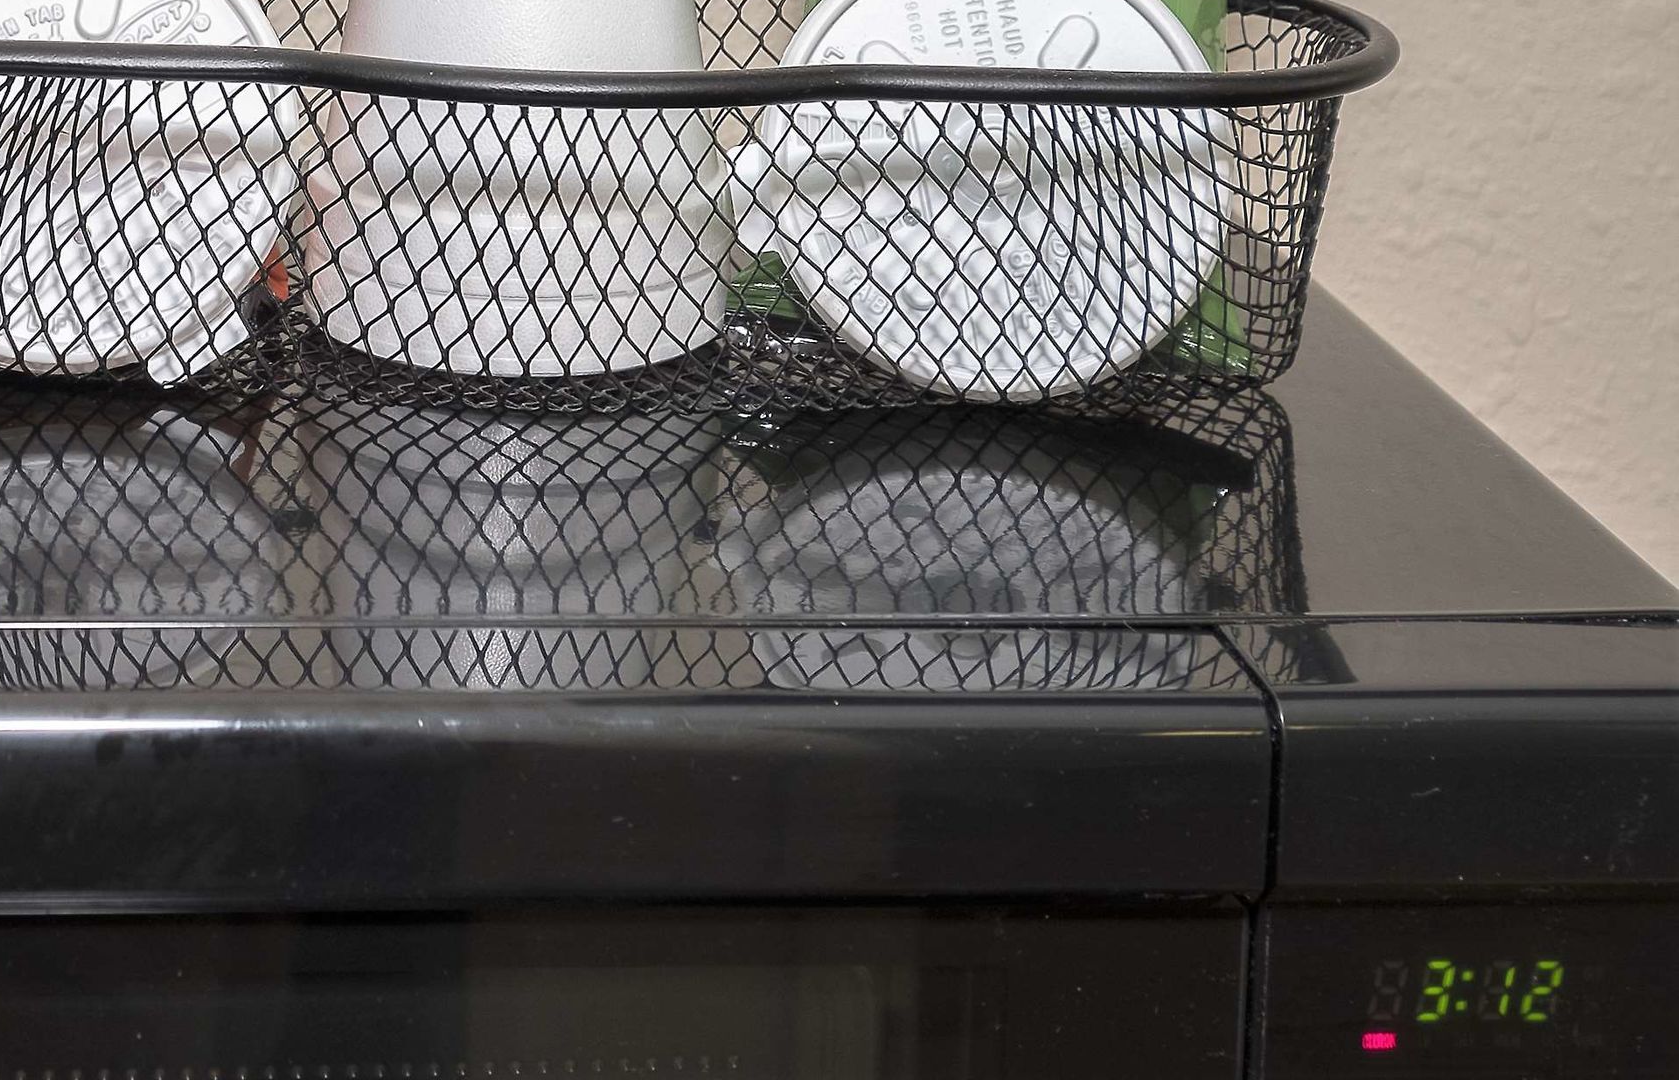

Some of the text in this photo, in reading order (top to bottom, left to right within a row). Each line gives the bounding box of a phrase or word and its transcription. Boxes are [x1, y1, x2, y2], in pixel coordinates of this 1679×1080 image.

[24, 3, 66, 27] TAB
[938, 10, 964, 49] HOT
[1417, 960, 1565, 1022] 3:12
